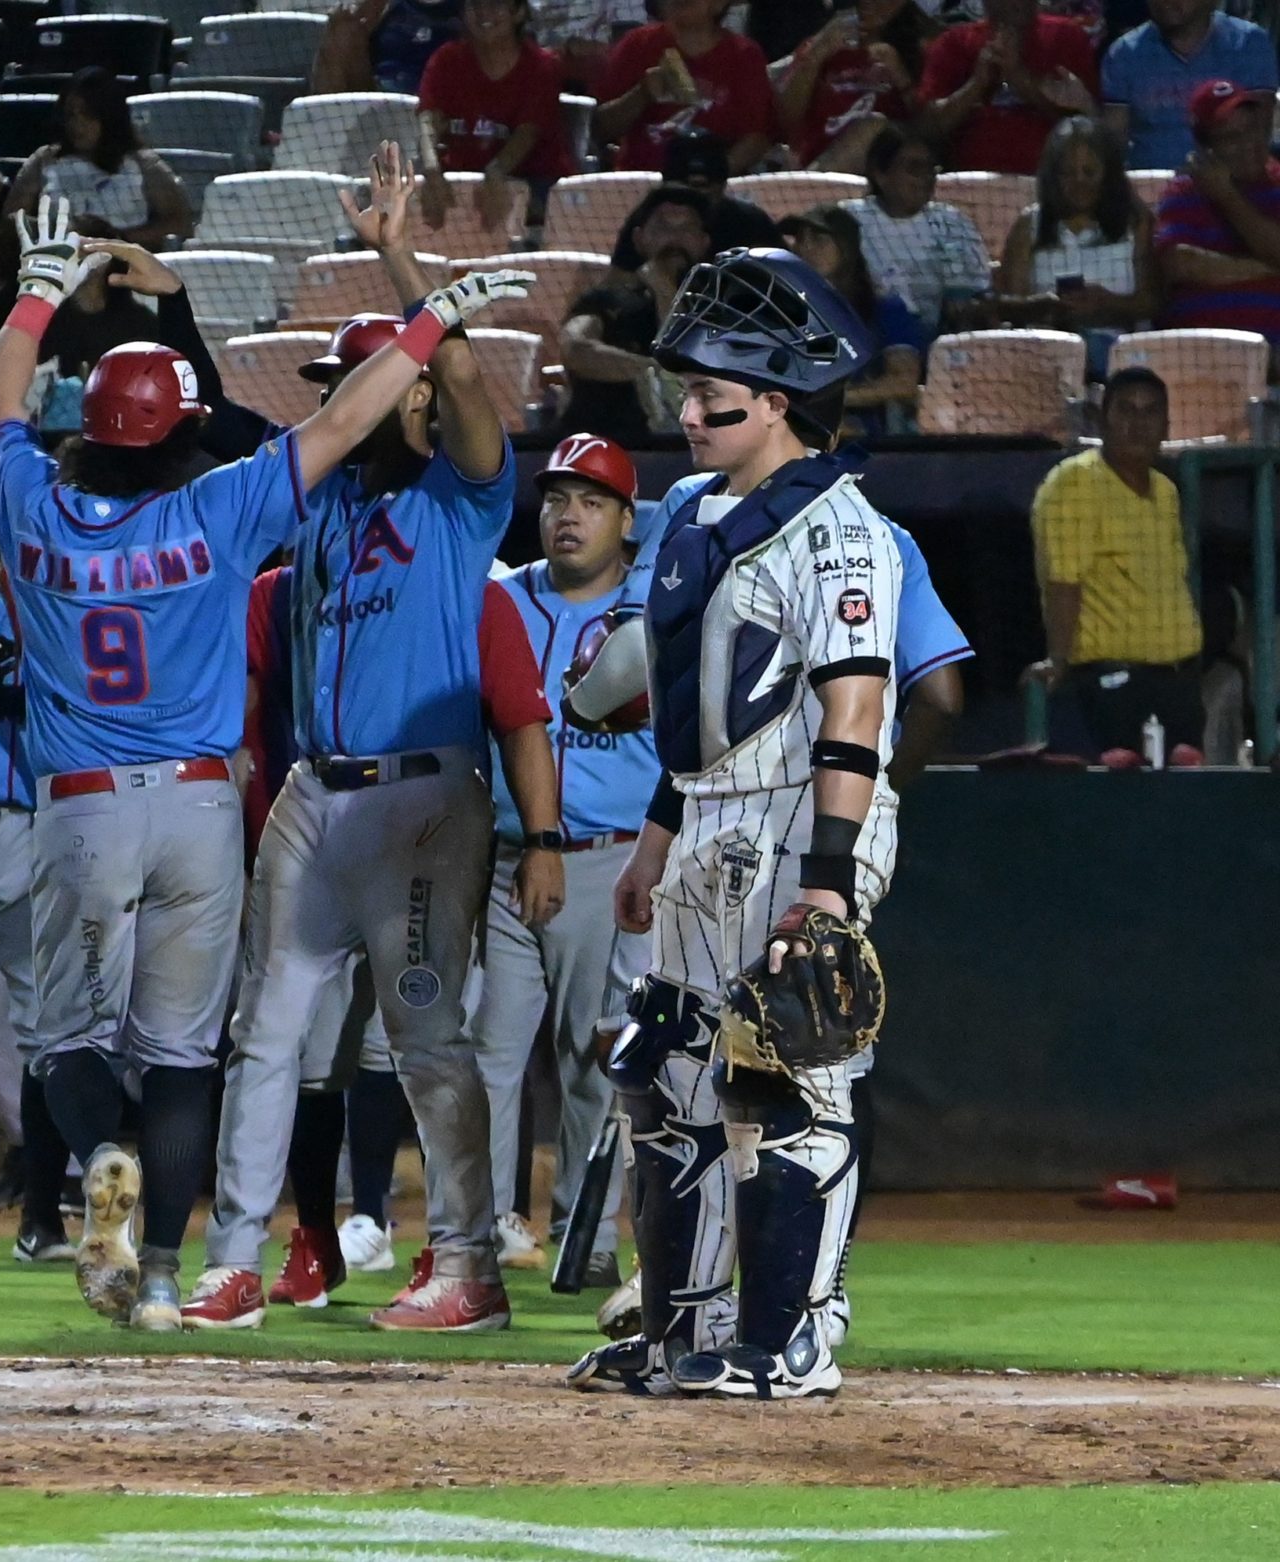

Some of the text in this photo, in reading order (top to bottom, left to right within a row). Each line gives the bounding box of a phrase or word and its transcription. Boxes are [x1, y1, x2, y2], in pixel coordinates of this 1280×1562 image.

[19, 540, 212, 593] WILLIAMS
[352, 506, 416, 576] A
[813, 557, 877, 575] SAL SOL
[842, 600, 868, 621] 34
[80, 605, 151, 707] 9
[406, 876, 424, 967] CAFIVER
